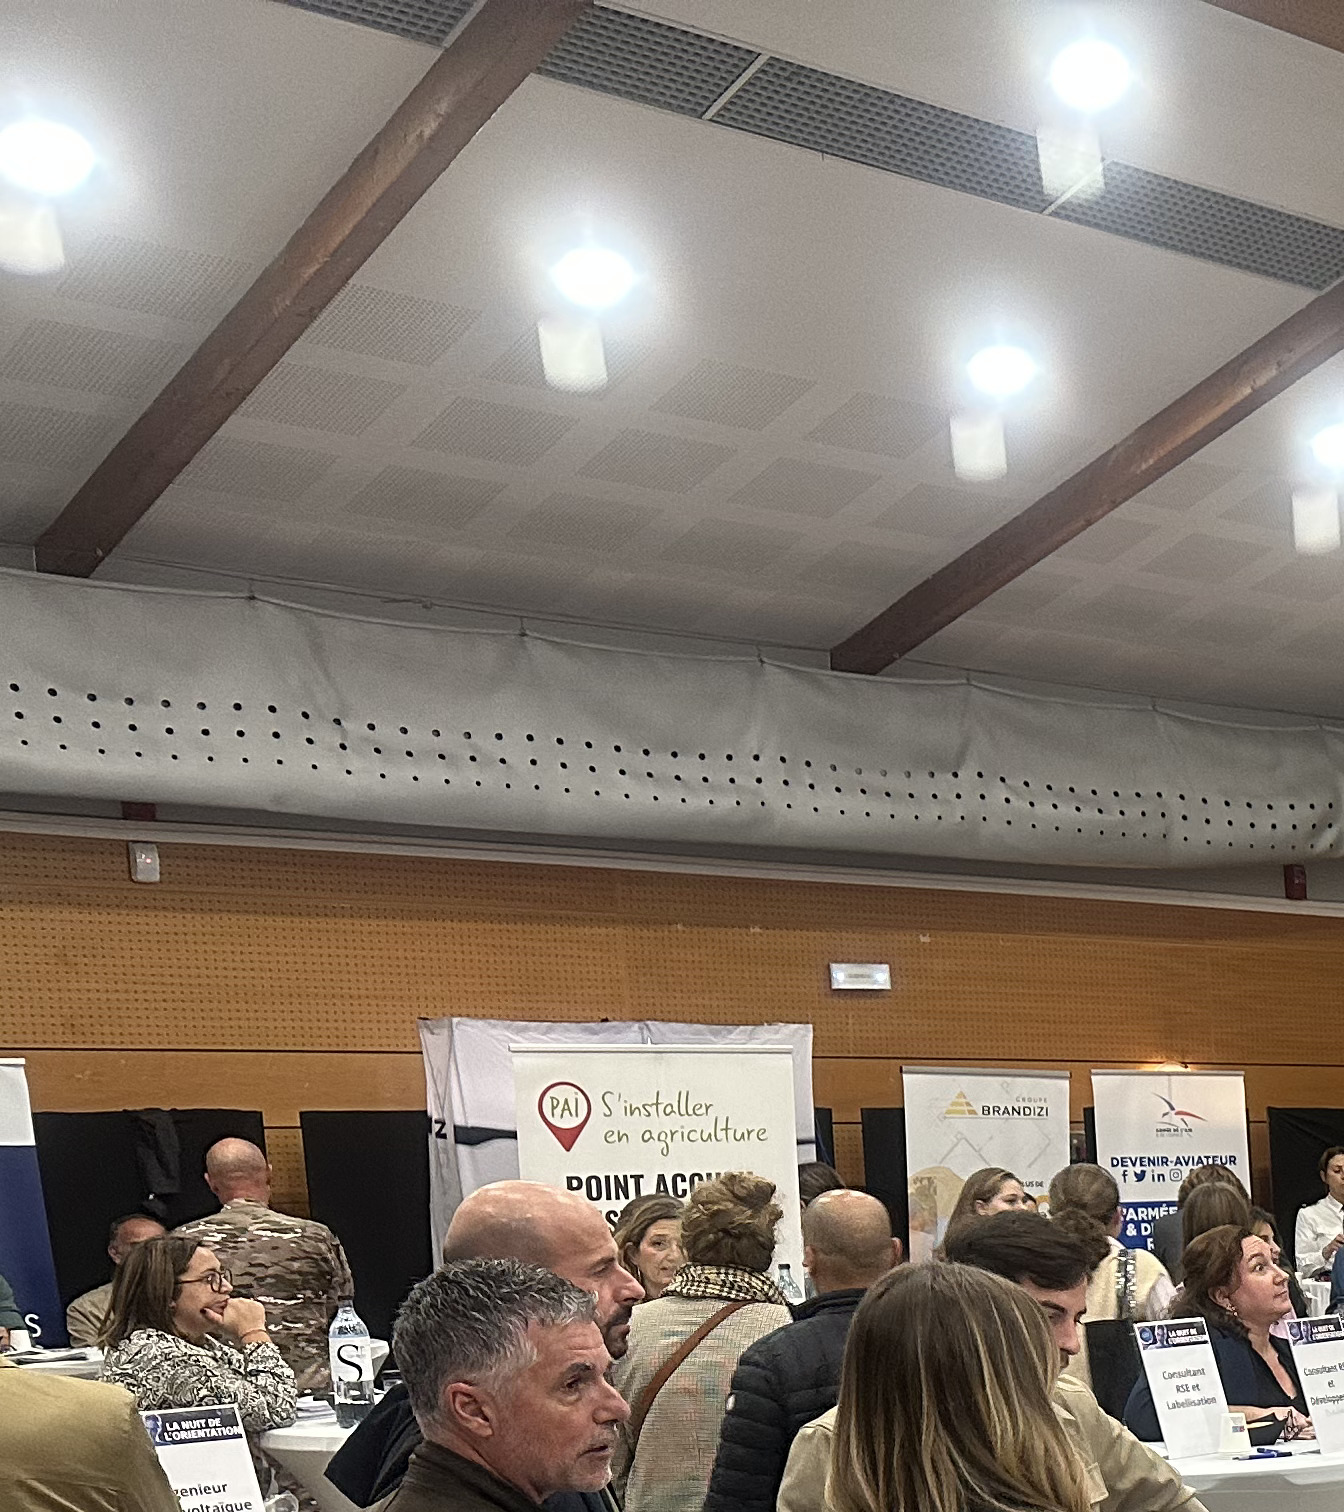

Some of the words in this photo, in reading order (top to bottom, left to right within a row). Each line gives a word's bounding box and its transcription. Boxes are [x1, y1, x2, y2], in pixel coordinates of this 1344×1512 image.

[602, 1091, 713, 1117] S'installer
[982, 1105, 1049, 1117] BRANDIZI
[604, 1129, 629, 1144] en
[641, 1116, 768, 1157] agriculture
[1111, 1155, 1237, 1168] DEVENIR-AVIATEUR
[566, 1174, 645, 1201] POINT
[1021, 1180, 1034, 1188] LUS
[1162, 1367, 1206, 1380] Consultant
[1175, 1383, 1190, 1394] RSE
[1192, 1383, 1201, 1392] et
[166, 1421, 182, 1432] LA
[181, 1418, 206, 1430] NUIT
[208, 1417, 222, 1427] DE
[164, 1425, 243, 1442] L'ORIENTATION
